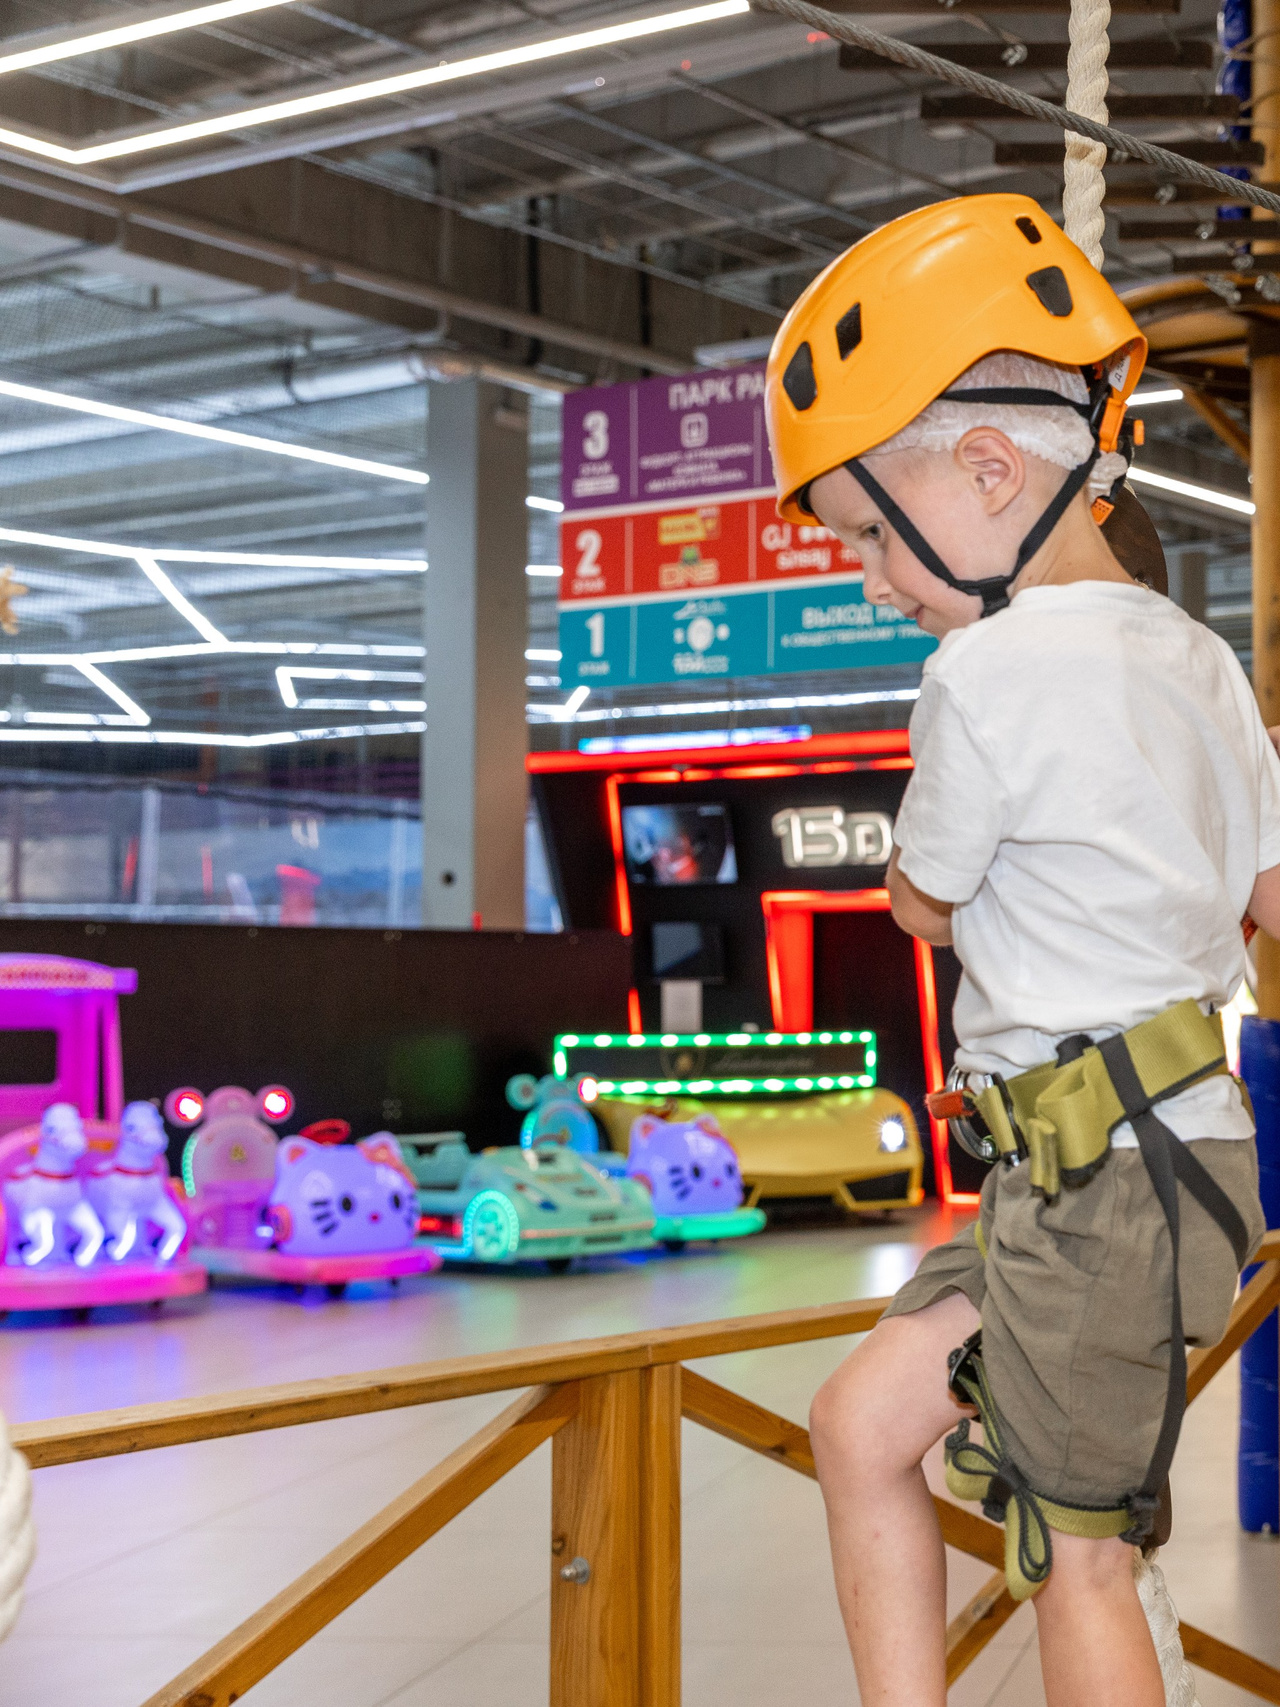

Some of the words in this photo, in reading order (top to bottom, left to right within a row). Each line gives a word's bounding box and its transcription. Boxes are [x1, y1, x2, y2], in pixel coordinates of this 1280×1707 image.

[668, 376, 733, 411] ПАРК
[582, 410, 610, 461] 3
[575, 529, 602, 577] 2
[585, 611, 605, 658] 1
[801, 602, 874, 629] ВЫХОД
